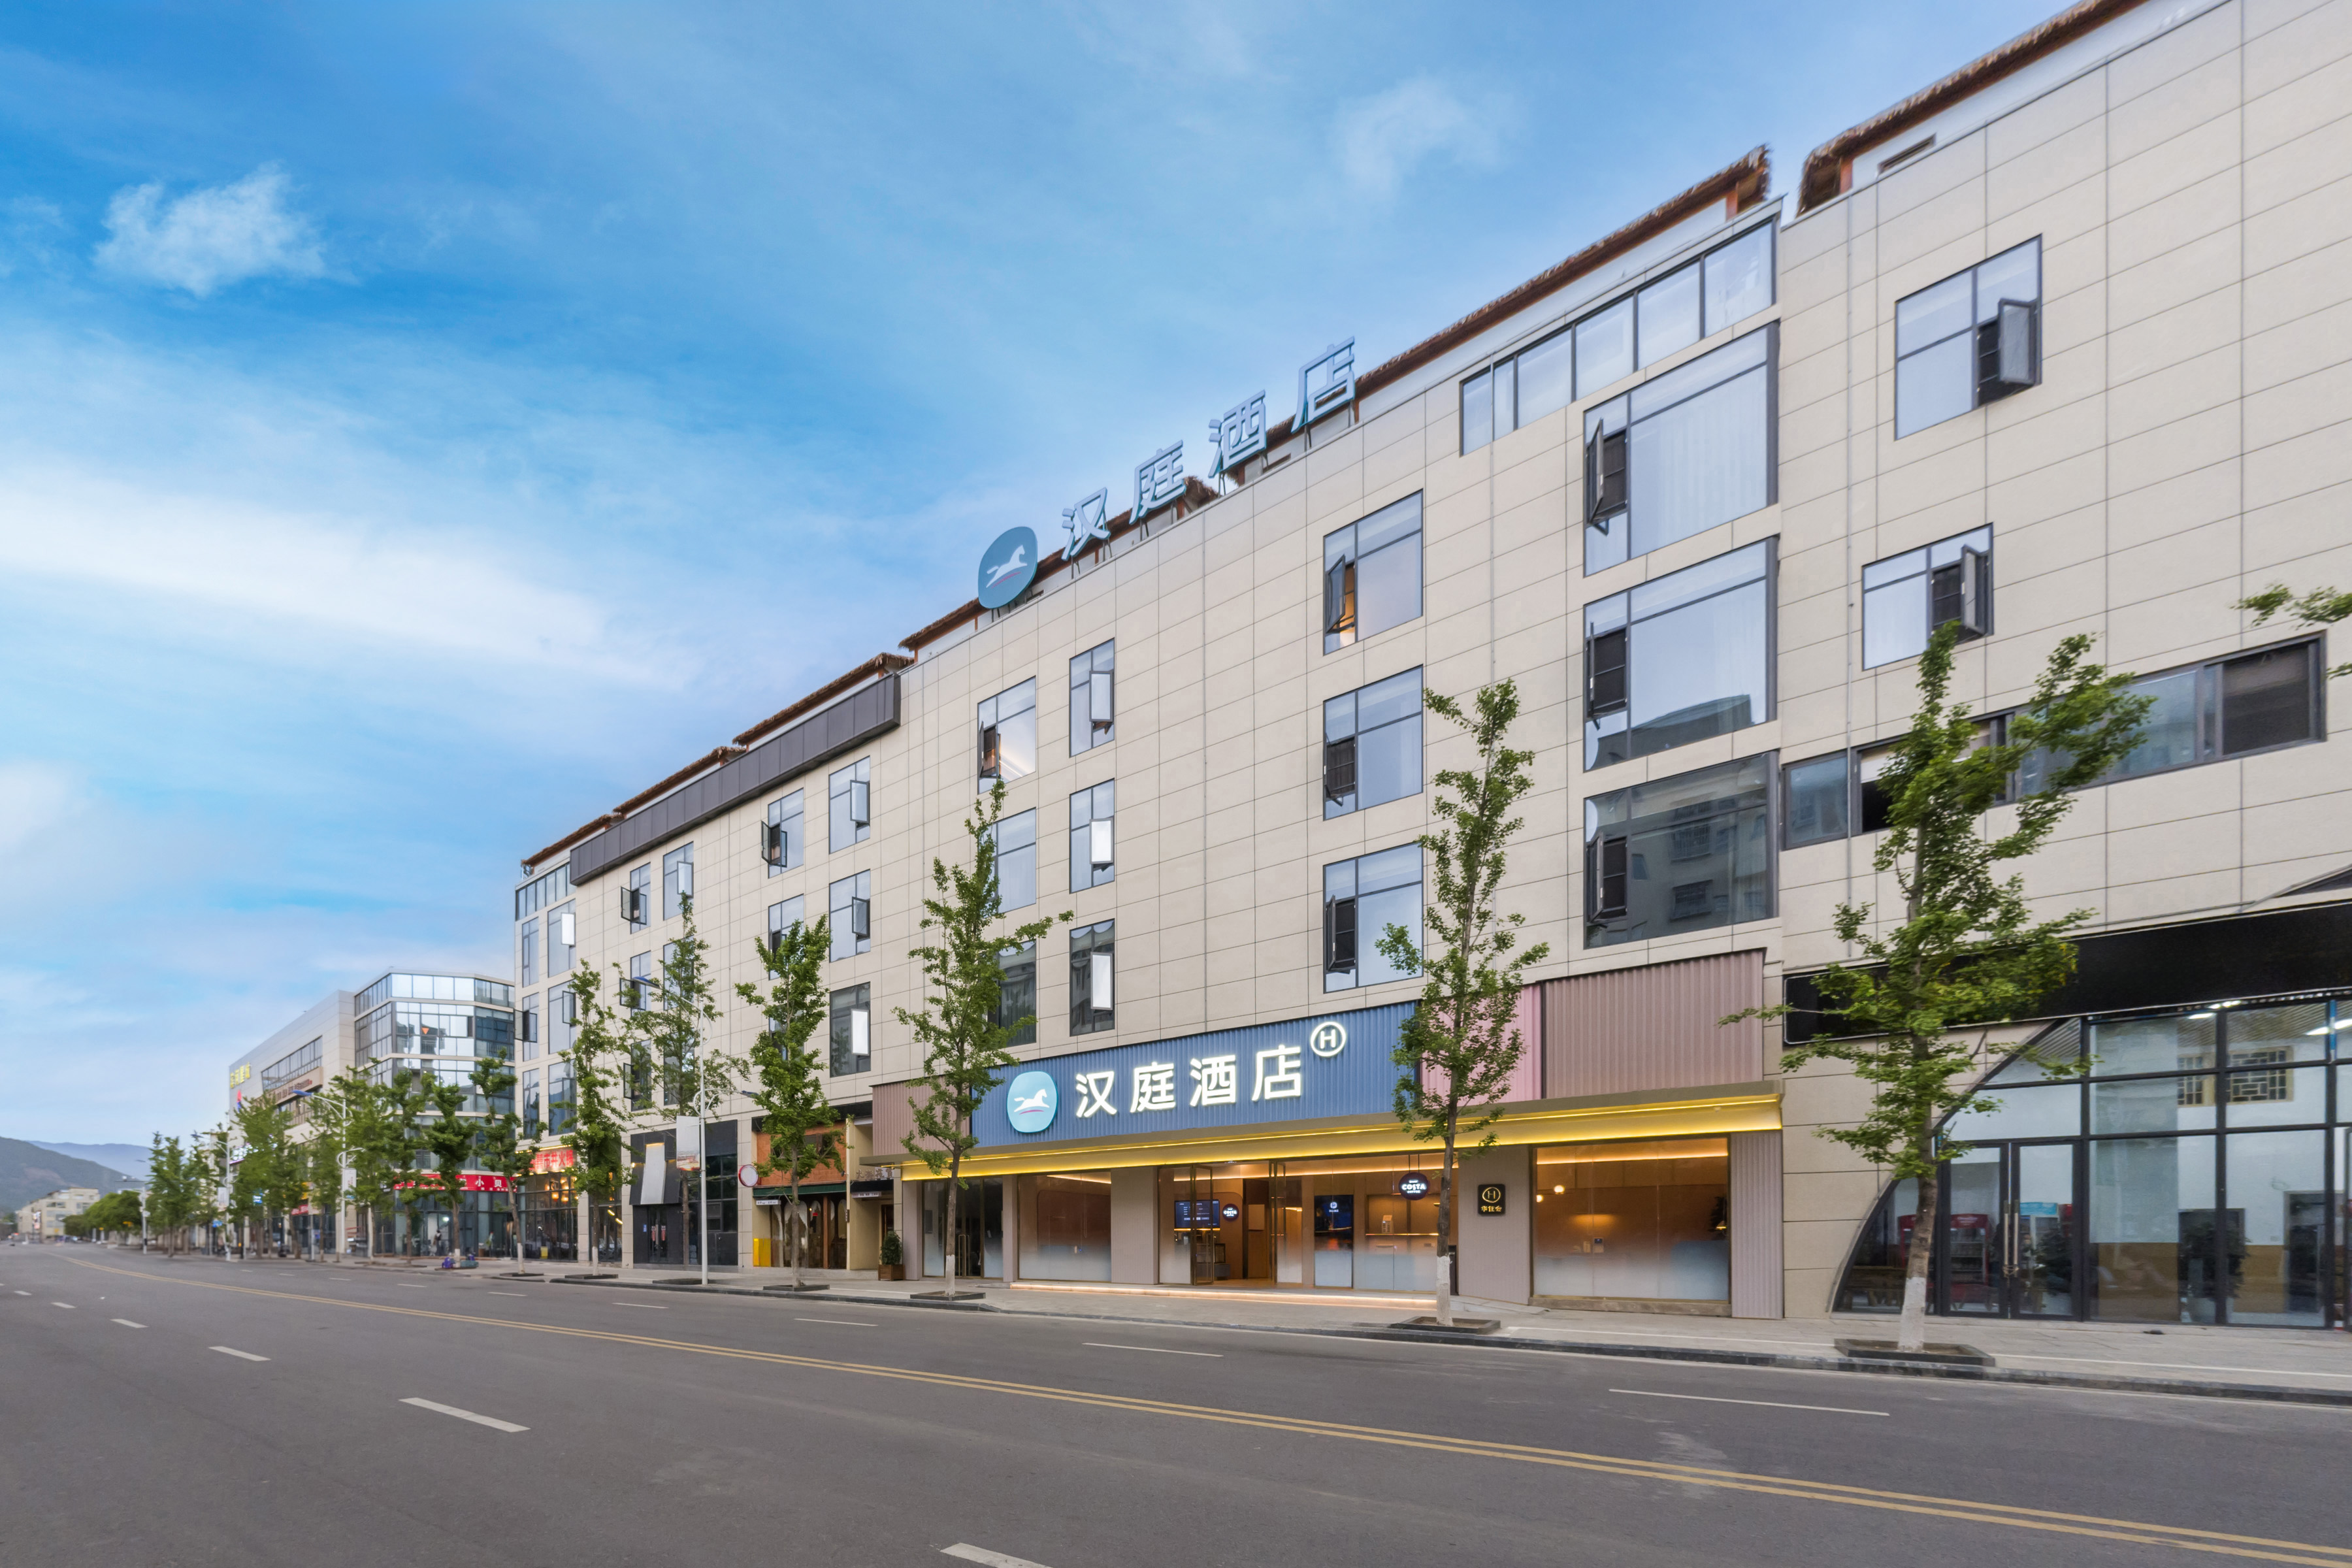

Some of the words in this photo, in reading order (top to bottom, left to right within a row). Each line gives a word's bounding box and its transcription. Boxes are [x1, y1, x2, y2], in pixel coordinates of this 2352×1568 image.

[1061, 336, 1356, 561] 汉庭酒店
[1075, 1045, 1302, 1118] 汉庭酒店
